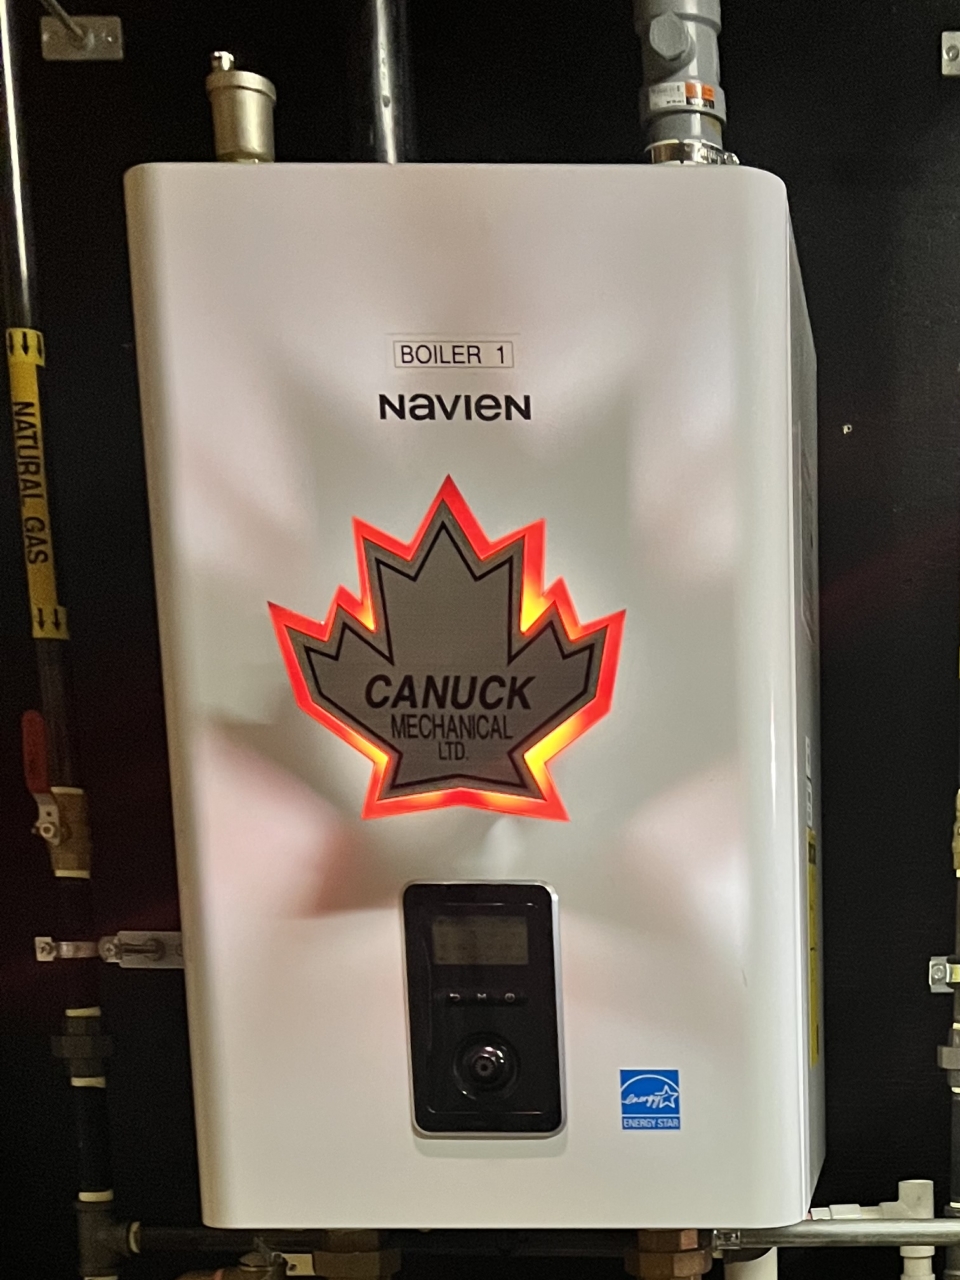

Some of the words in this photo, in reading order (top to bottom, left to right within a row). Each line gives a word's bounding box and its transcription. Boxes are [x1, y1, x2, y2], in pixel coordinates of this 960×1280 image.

[400, 344, 482, 365] BOILER
[496, 345, 505, 365] 1
[13, 401, 44, 508] NATURAL
[24, 516, 49, 565] GAS
[364, 673, 537, 711] CANUCK
[390, 713, 514, 741] MECHANICAL
[437, 740, 470, 761] LTD.
[623, 1117, 656, 1129] ENERGY
[657, 1117, 680, 1129] STAR
